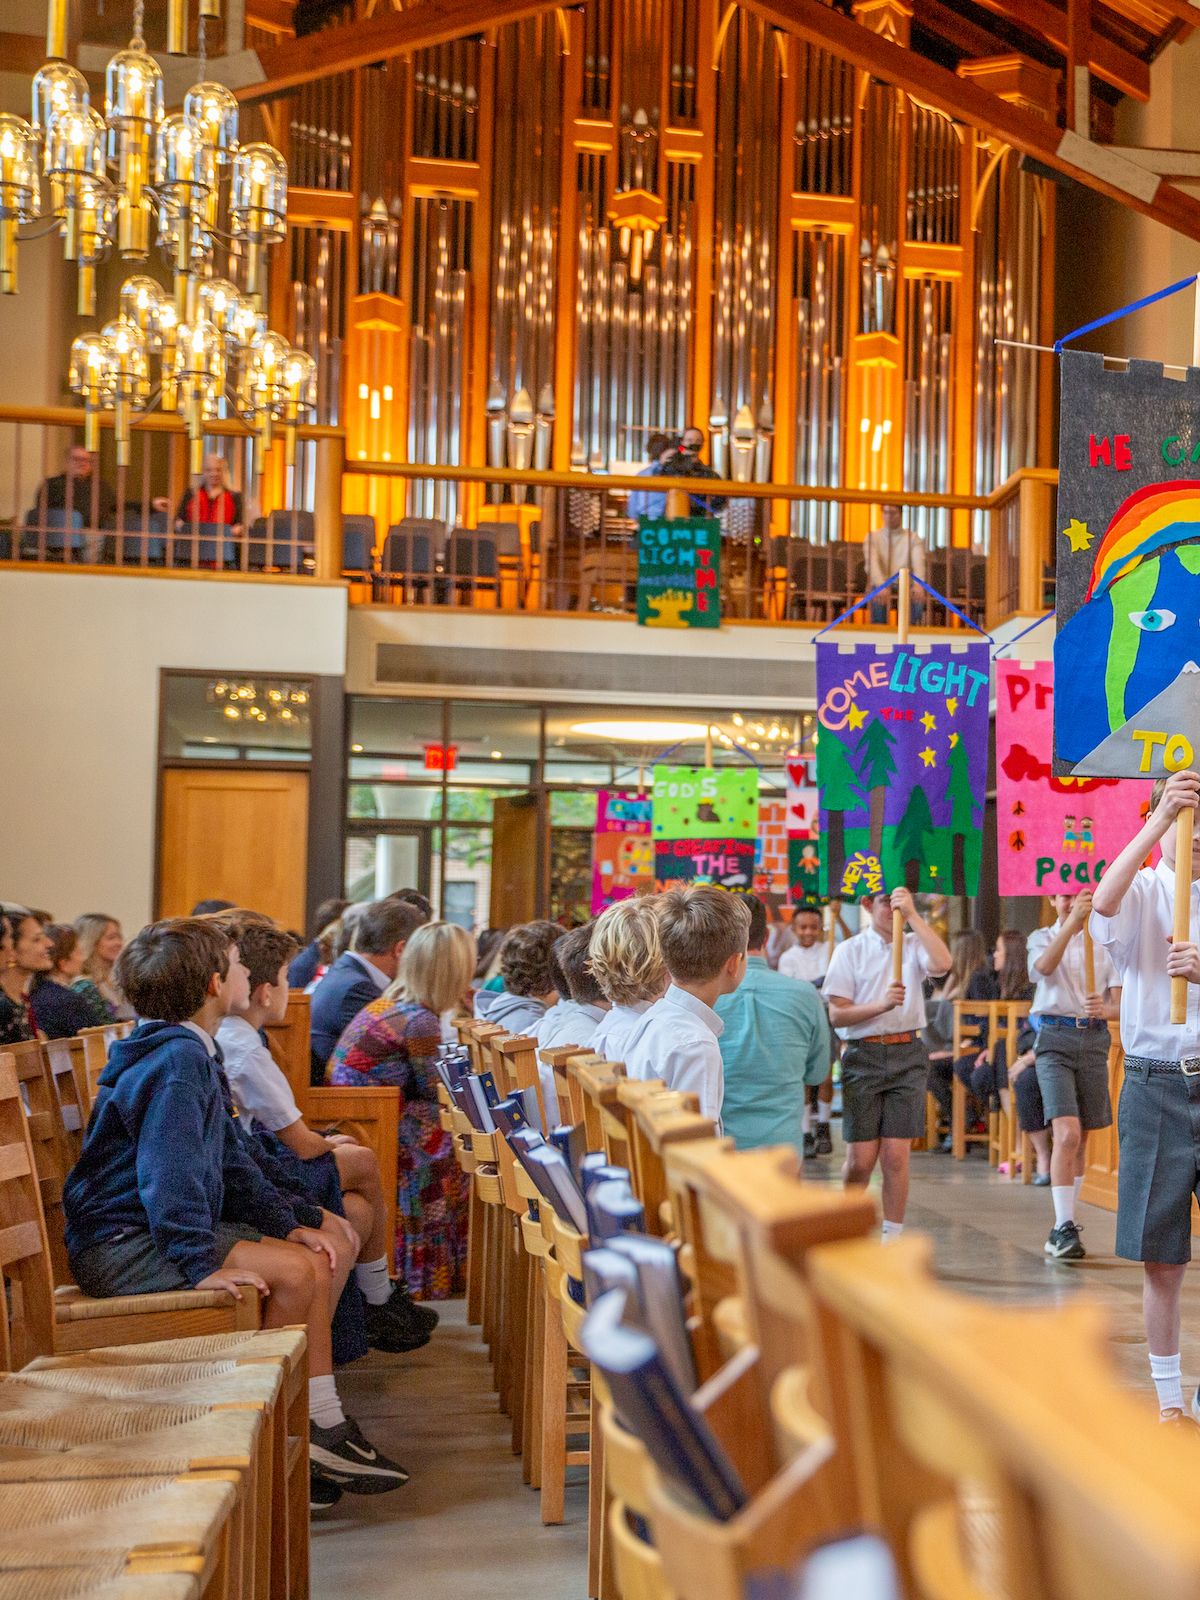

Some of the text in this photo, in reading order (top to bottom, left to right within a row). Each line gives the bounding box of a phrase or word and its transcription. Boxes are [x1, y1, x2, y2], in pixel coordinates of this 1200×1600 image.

[1089, 434, 1132, 472] HE
[817, 652, 989, 731] COME LIGHT
[880, 706, 915, 721] THE
[1132, 730, 1194, 773] TO
[691, 854, 741, 876] THE
[1036, 857, 1112, 887] Peac
